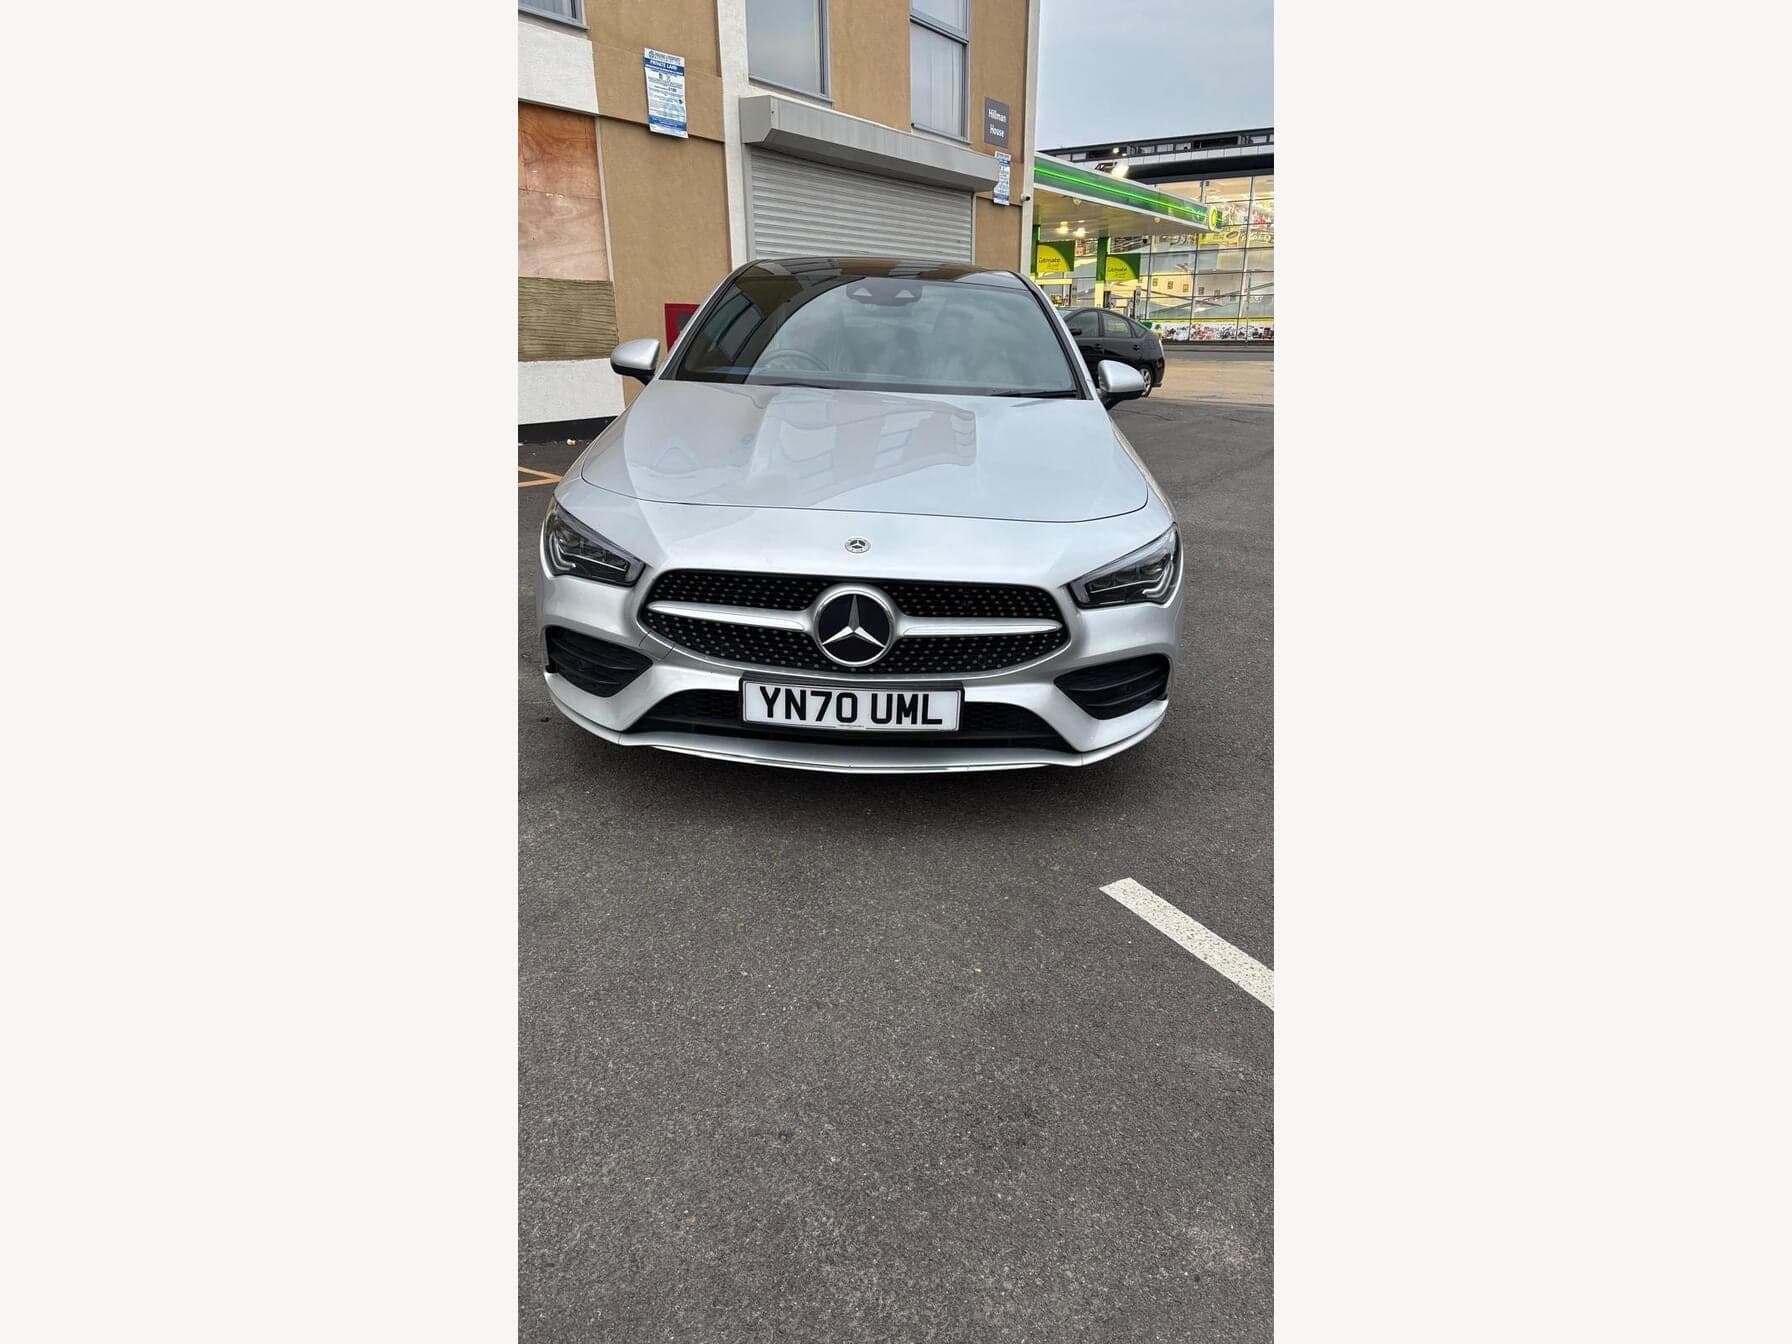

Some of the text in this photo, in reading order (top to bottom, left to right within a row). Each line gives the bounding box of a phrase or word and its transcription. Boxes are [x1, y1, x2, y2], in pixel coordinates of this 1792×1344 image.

[988, 109, 1006, 122] Hillman
[990, 124, 1004, 137] House
[759, 686, 943, 725] YN70 UML
